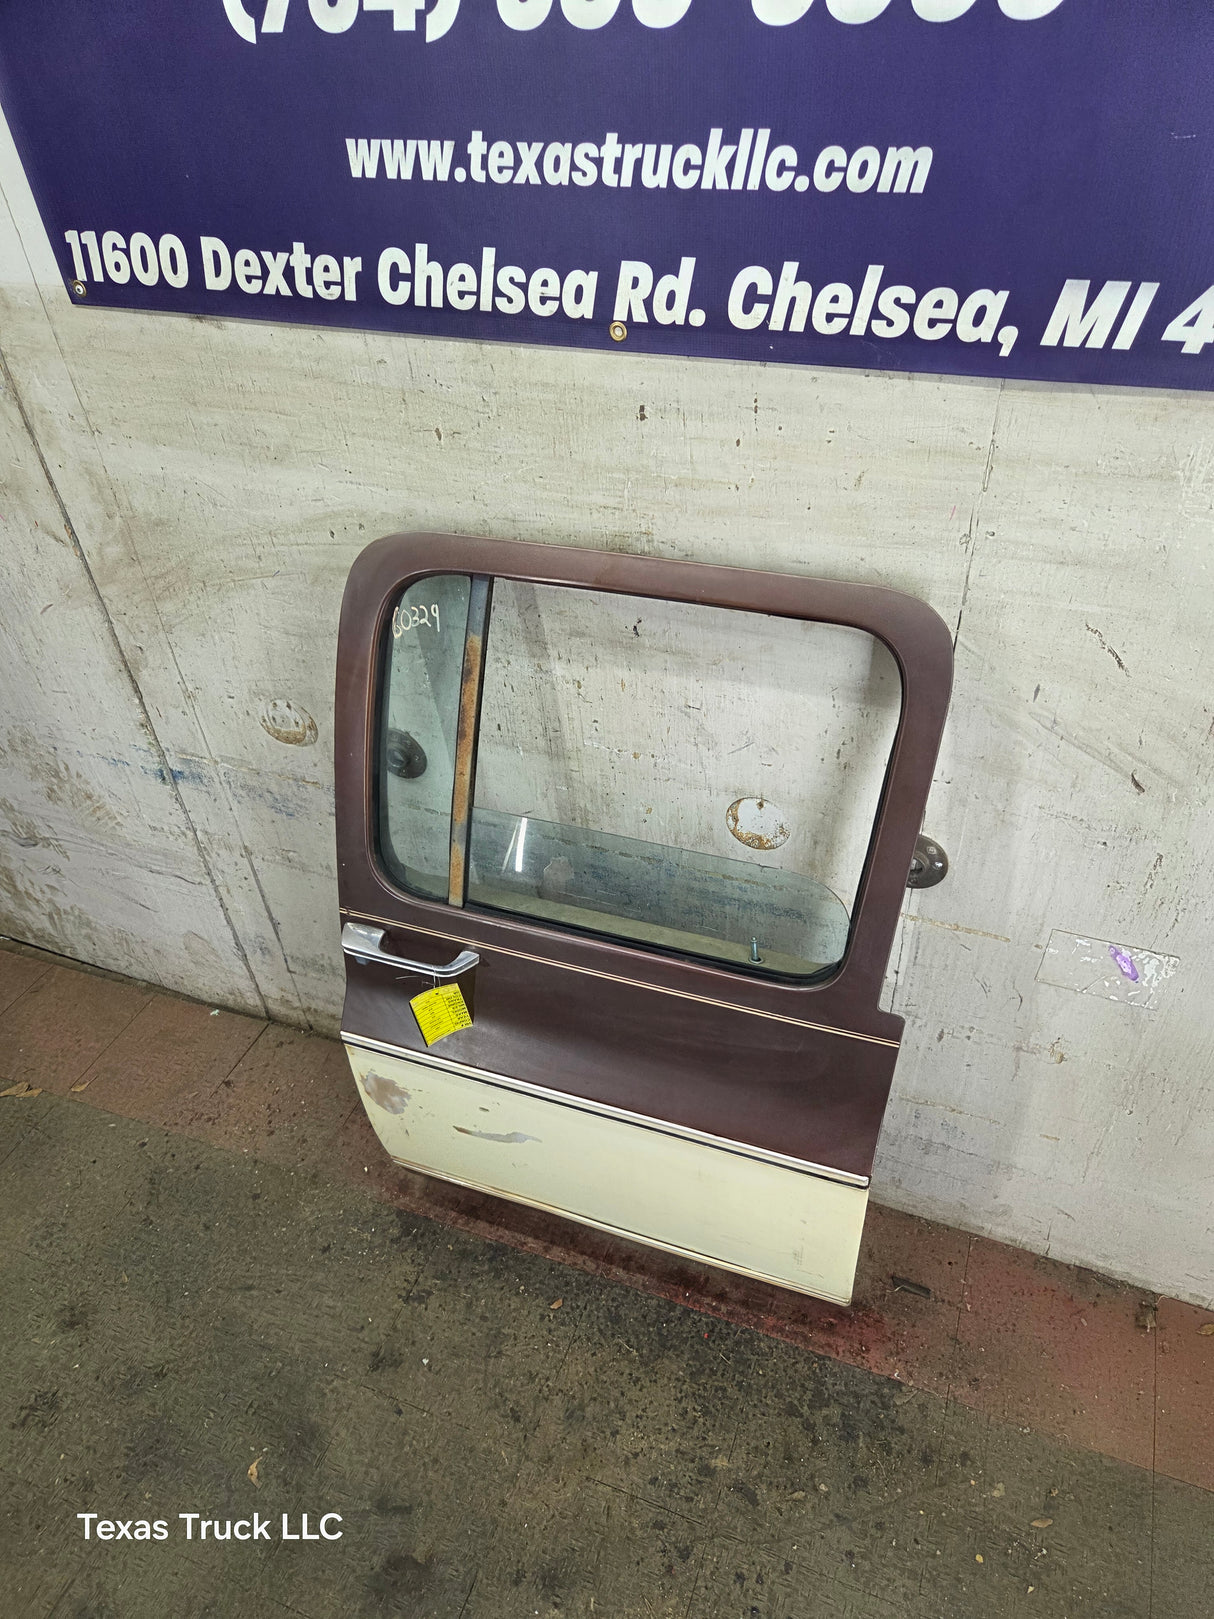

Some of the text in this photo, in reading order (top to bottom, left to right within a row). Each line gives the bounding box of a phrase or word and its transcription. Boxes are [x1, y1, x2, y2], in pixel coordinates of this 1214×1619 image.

[345, 128, 934, 194] www.texastruckllc.com
[65, 230, 189, 289] 11600
[200, 236, 362, 302] Dexter
[378, 243, 599, 320] Chelsea
[613, 257, 706, 327] Rd.
[728, 262, 1019, 357] Chelsea,
[1040, 279, 1160, 350] MI
[392, 603, 440, 639] 60329
